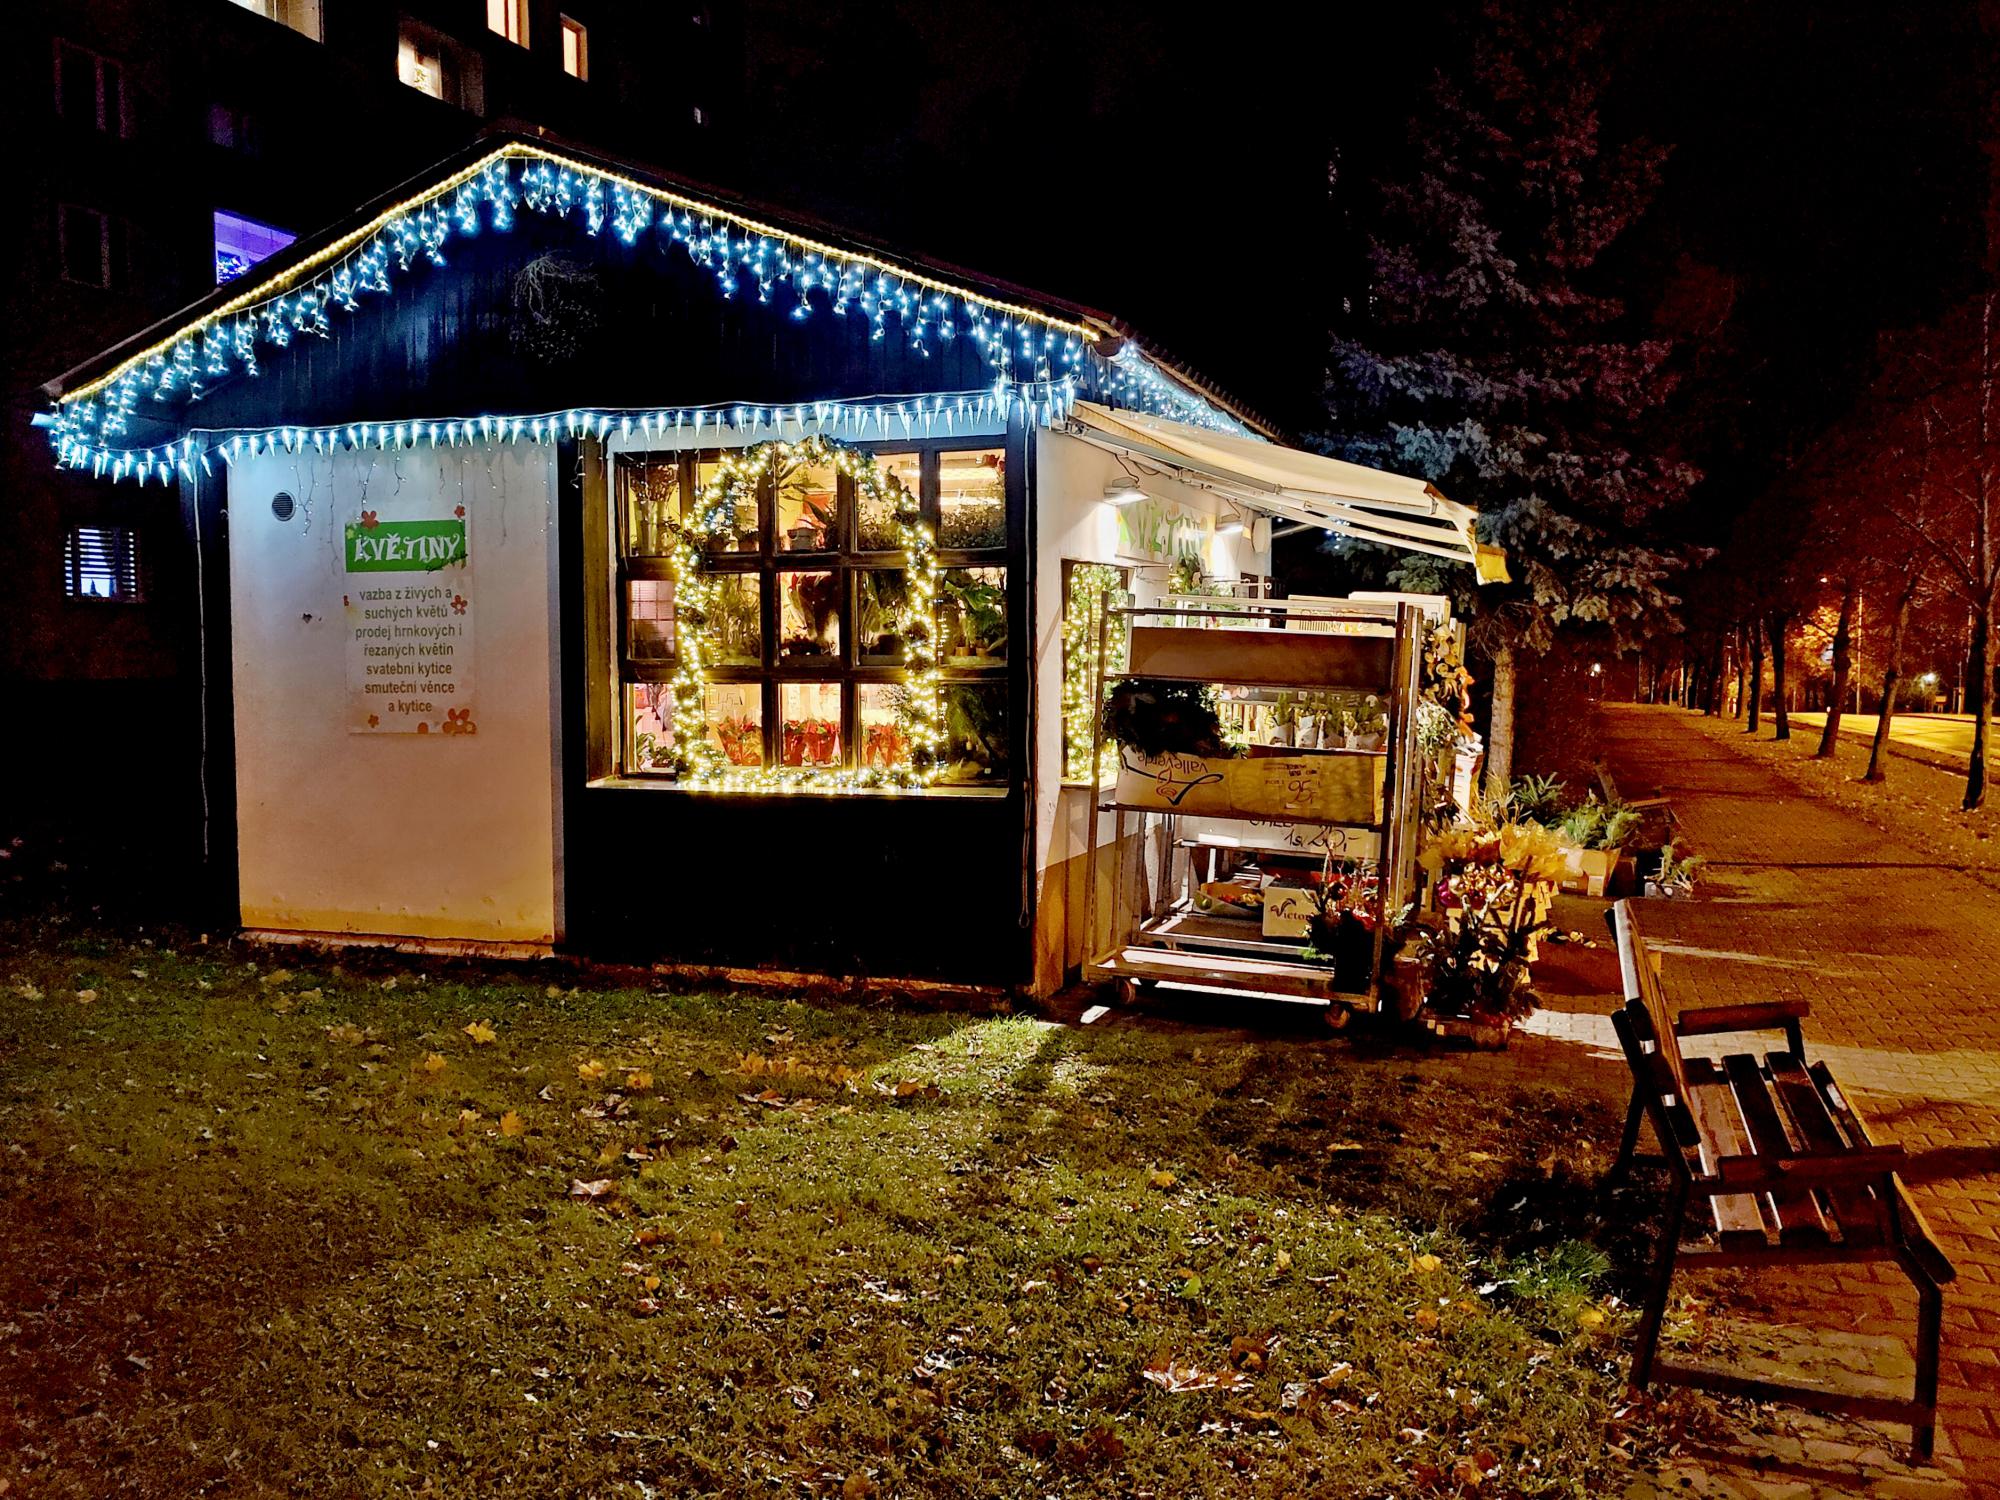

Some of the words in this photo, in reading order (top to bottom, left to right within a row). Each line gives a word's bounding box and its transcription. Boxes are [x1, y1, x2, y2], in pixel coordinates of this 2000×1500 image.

[354, 532, 460, 563] KVĚTINY
[360, 588, 392, 601] vazba
[395, 590, 401, 600] z
[405, 586, 442, 602] živých
[445, 588, 452, 599] a
[365, 606, 413, 622] suchých
[416, 604, 448, 618] květů
[355, 626, 391, 641] prodej
[394, 624, 455, 640] hrnkových
[458, 624, 462, 636] i
[364, 643, 415, 659] řezaných
[418, 642, 454, 656] květin
[366, 661, 414, 675] svatební
[417, 662, 452, 677] kytice
[365, 680, 417, 694] smuteční
[420, 680, 455, 693] věnce
[388, 701, 395, 712] a
[398, 700, 432, 715] kytice
